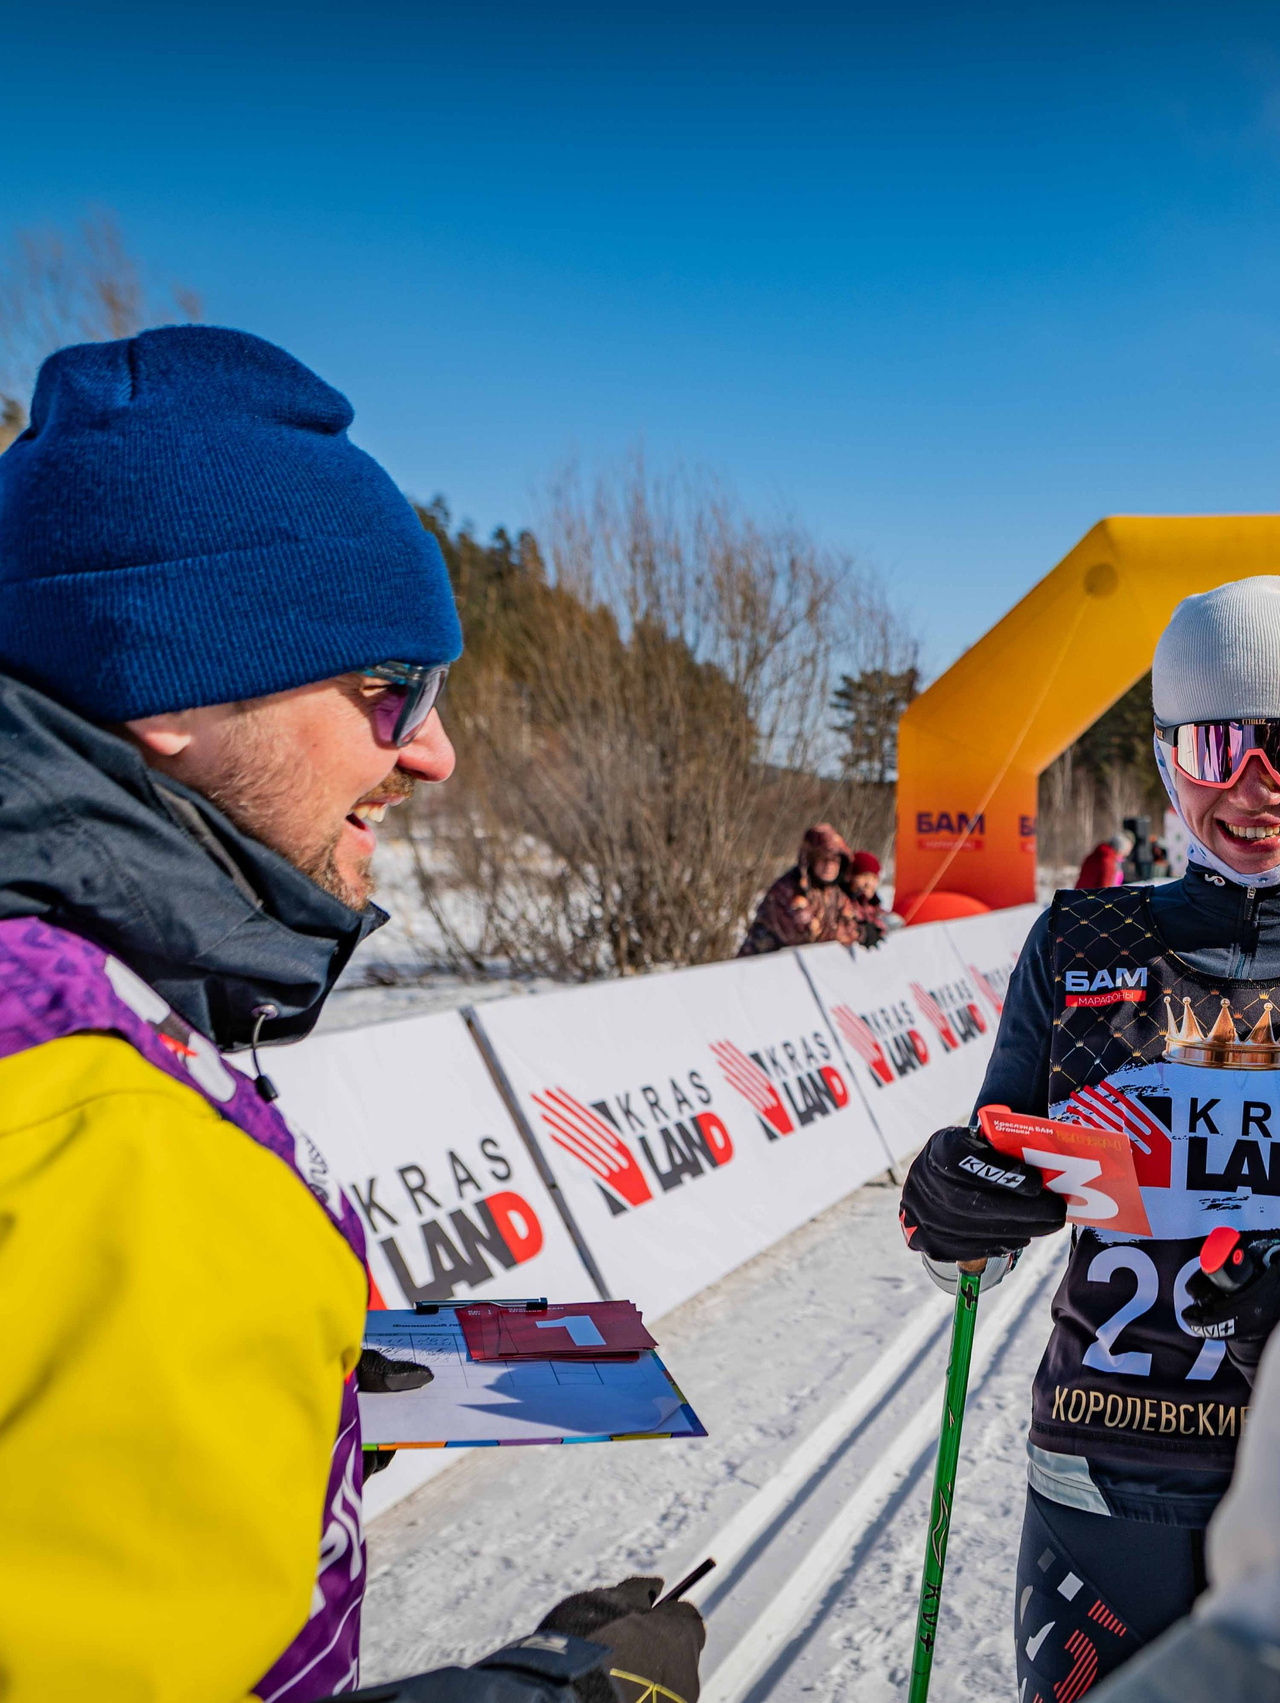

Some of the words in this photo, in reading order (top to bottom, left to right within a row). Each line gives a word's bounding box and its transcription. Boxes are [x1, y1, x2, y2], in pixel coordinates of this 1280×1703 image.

[916, 812, 985, 835] БАМ
[1065, 967, 1147, 991] БАМ
[1078, 992, 1134, 1005] МАРАФОНЫ
[766, 1031, 831, 1078] KRAS
[884, 1029, 929, 1078] LAND
[615, 1070, 712, 1132] KRAS
[783, 1066, 848, 1127] LAND
[637, 1111, 734, 1193] LAND
[1035, 1125, 1053, 1135] БАМ
[352, 1138, 511, 1233] KRAS
[1021, 1147, 1119, 1219] 3
[379, 1191, 543, 1302] LAND
[535, 1315, 607, 1346] 1
